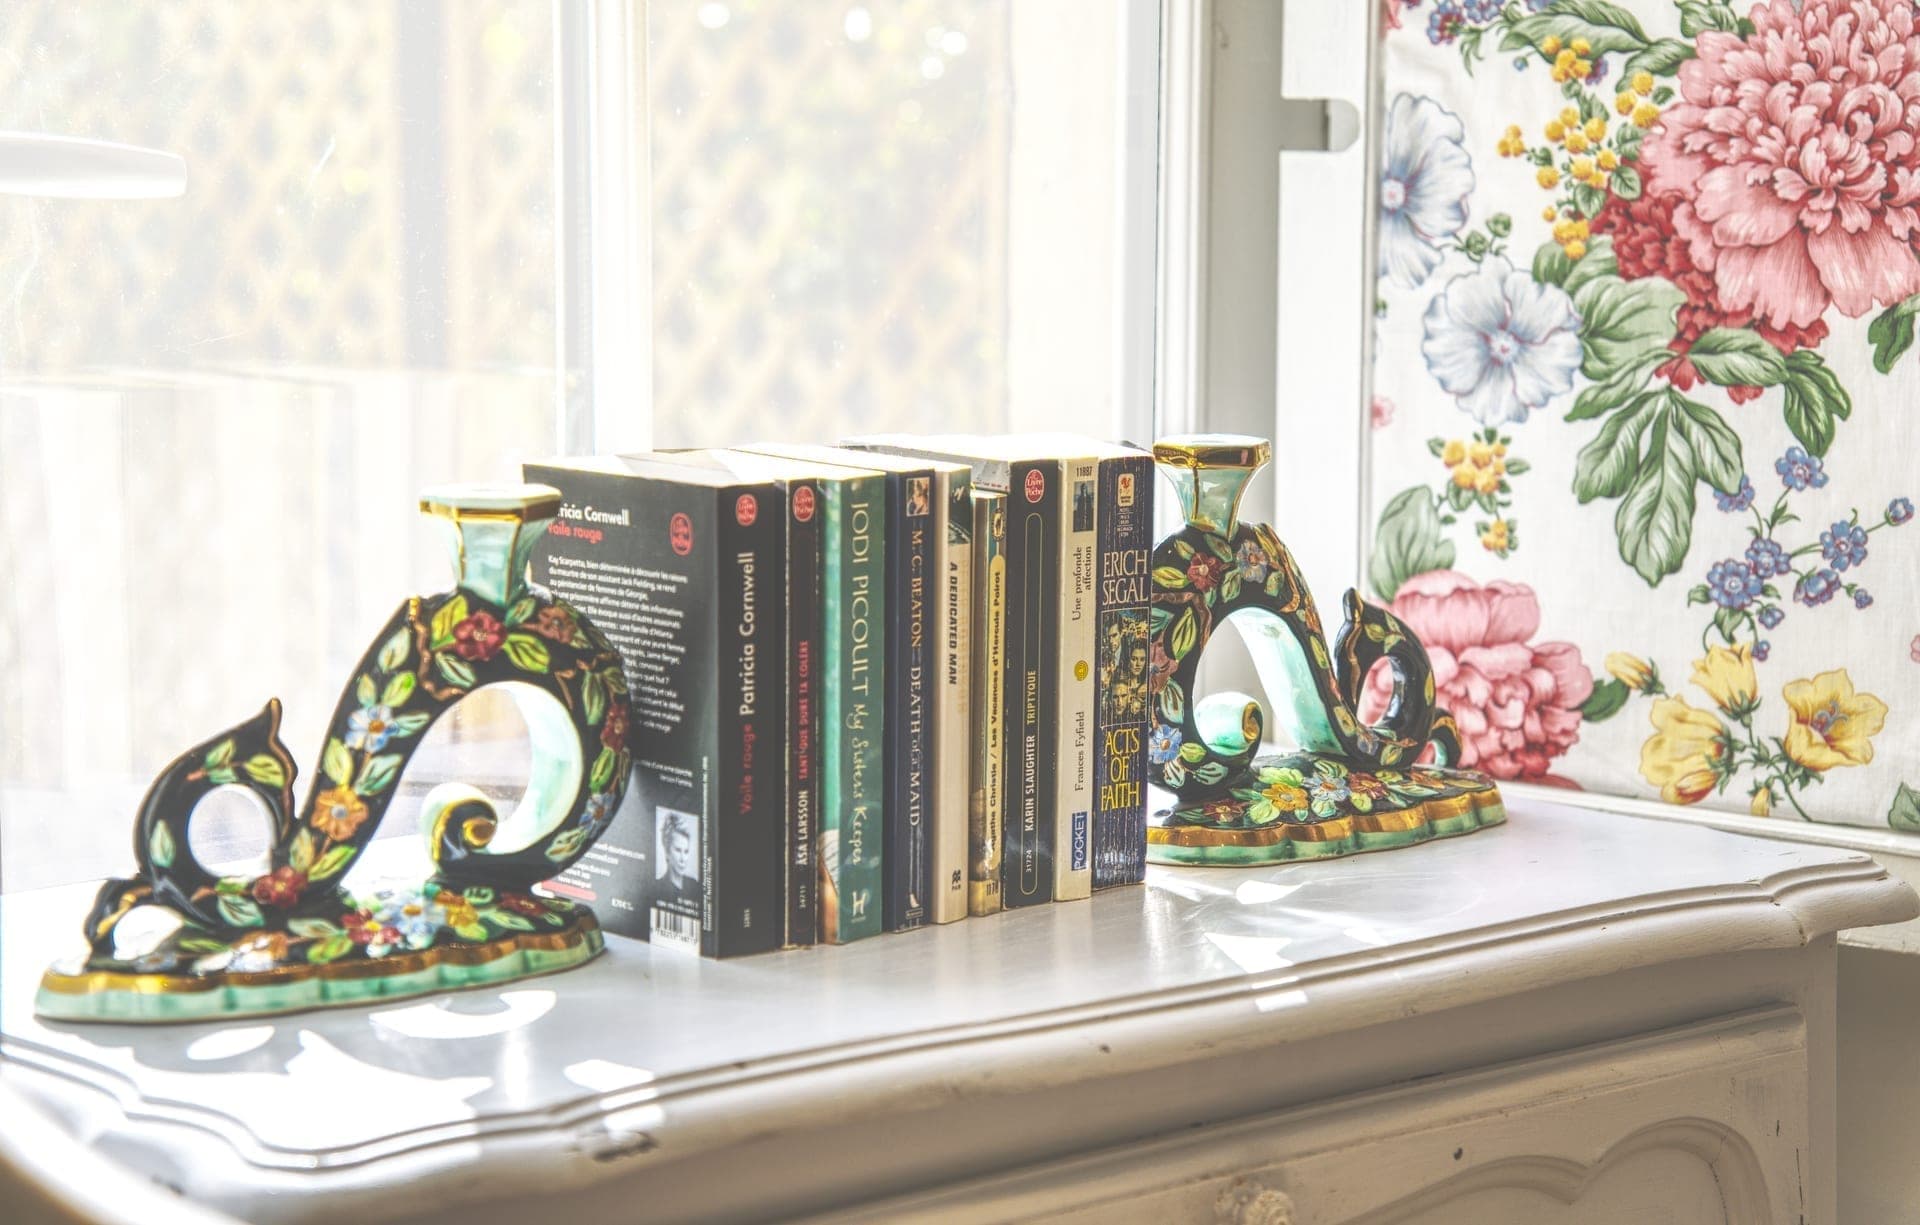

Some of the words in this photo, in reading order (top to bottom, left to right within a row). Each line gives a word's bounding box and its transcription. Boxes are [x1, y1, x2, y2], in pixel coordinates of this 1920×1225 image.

[557, 503, 582, 520] ricia
[584, 506, 630, 526] Cornwell
[573, 527, 603, 544] rouge
[851, 503, 869, 563] JODI
[911, 530, 923, 549] M.
[911, 555, 923, 572] C.
[949, 562, 958, 571] A
[1073, 547, 1083, 594] profonde
[1082, 546, 1092, 591] affection
[1103, 549, 1148, 578] ERICH
[737, 552, 755, 636] Cornwell
[993, 572, 1001, 607] Poirot
[1072, 597, 1082, 621] Une
[1103, 577, 1148, 606] SEGAL
[911, 578, 923, 648] BEATON
[949, 575, 958, 649] DEDICATED
[852, 575, 869, 697] PICOULT
[992, 610, 1000, 667] d'Hercule
[739, 644, 755, 716] Patricia
[949, 653, 958, 685] MAN
[846, 703, 869, 730] My
[910, 667, 921, 733] DEATH
[991, 670, 999, 725] Vacances
[1027, 670, 1037, 725] TRIPTYQUE
[743, 723, 757, 769] rouge
[1075, 711, 1086, 747] Fyfield
[1104, 728, 1140, 756] ACTS
[798, 755, 808, 780] TANT
[990, 763, 998, 807] Christie
[1025, 735, 1036, 795] SLAUGHTER
[1074, 750, 1085, 792] Frances
[1110, 756, 1130, 783] OF
[739, 775, 753, 815] Voile
[798, 790, 808, 841] LARSSON
[910, 772, 921, 826] MAID
[1025, 797, 1034, 832] KARIN
[1101, 781, 1140, 811] FAITH
[795, 843, 808, 865] ÅSA
[848, 805, 867, 865] Keeper
[1073, 815, 1087, 870] POCKET
